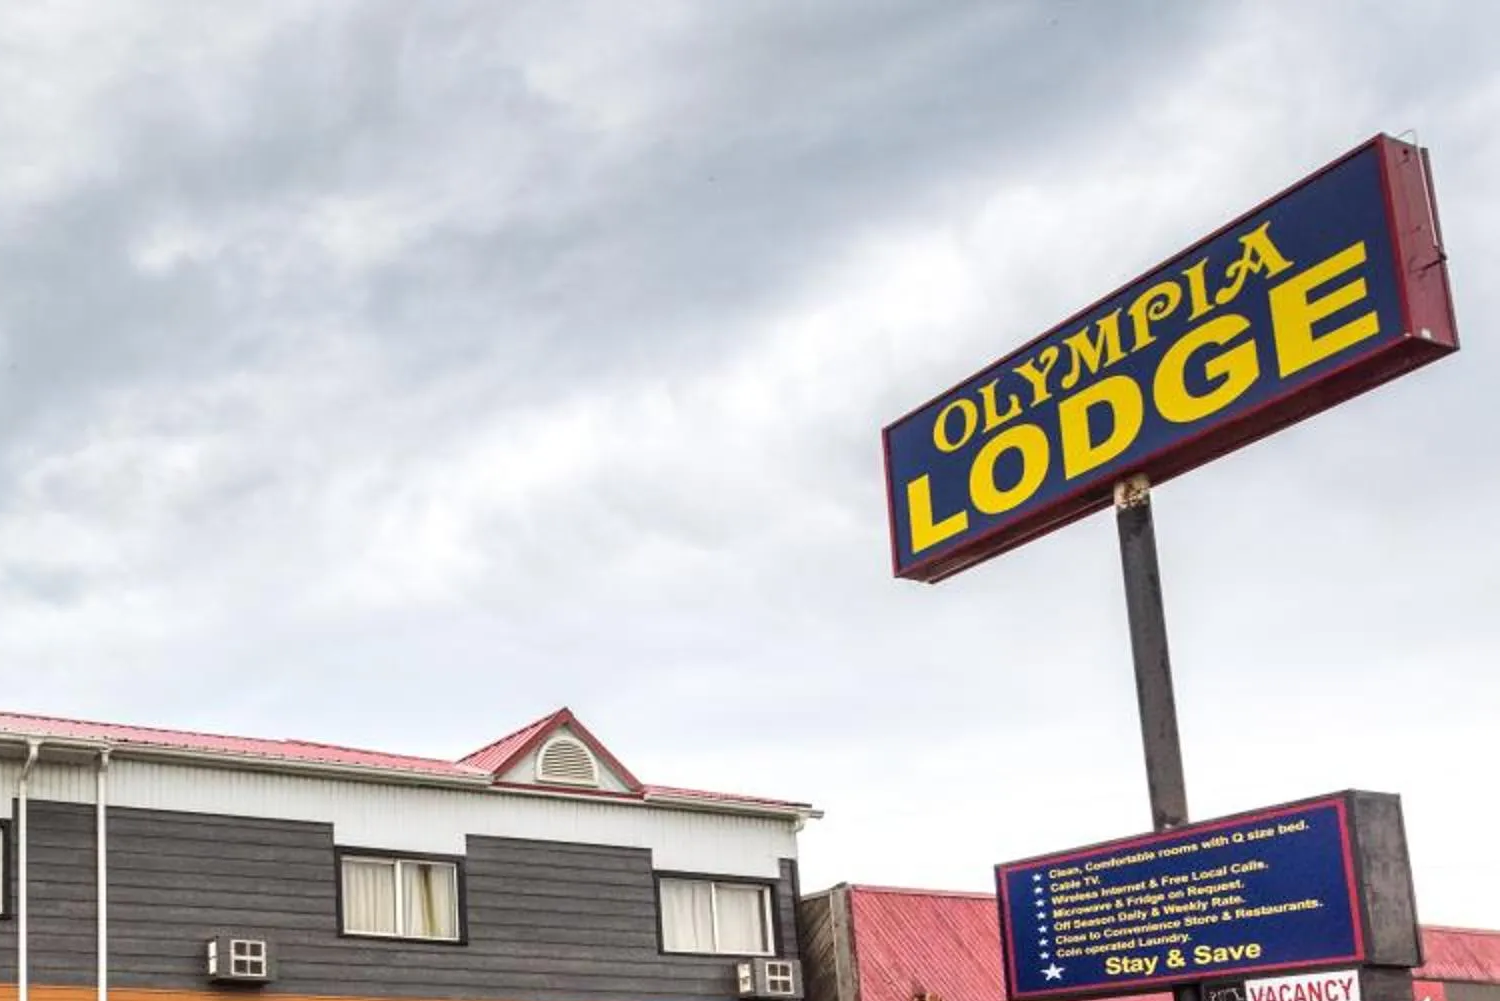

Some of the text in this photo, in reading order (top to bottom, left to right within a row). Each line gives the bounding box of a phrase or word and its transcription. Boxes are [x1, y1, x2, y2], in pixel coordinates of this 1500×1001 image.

[933, 221, 1294, 455] OLYMPIA
[907, 240, 1381, 555] LODGE
[1085, 852, 1156, 872] Comfortable
[1158, 844, 1198, 857] rooms
[1202, 836, 1229, 849] with
[1232, 832, 1244, 843] Q
[1247, 828, 1275, 840] size
[1278, 819, 1310, 835] bed.
[1050, 880, 1081, 892] Cable
[1052, 860, 1269, 905] Wireless Internet & Free Local Calls.
[1052, 880, 1244, 918] Microwave & Fridge on Request.
[1054, 920, 1071, 932] Off
[1074, 915, 1115, 928] Season
[1118, 910, 1148, 922] Daily
[1151, 907, 1160, 917] &
[1163, 900, 1208, 914] Weekly
[1055, 934, 1087, 944] Close
[1089, 931, 1102, 941] to
[1103, 919, 1181, 938] Convenience
[1184, 914, 1219, 928] Store
[1221, 911, 1233, 922] &
[1056, 932, 1192, 958] Coin operated Laundry.
[1105, 943, 1262, 976] Stay & Save
